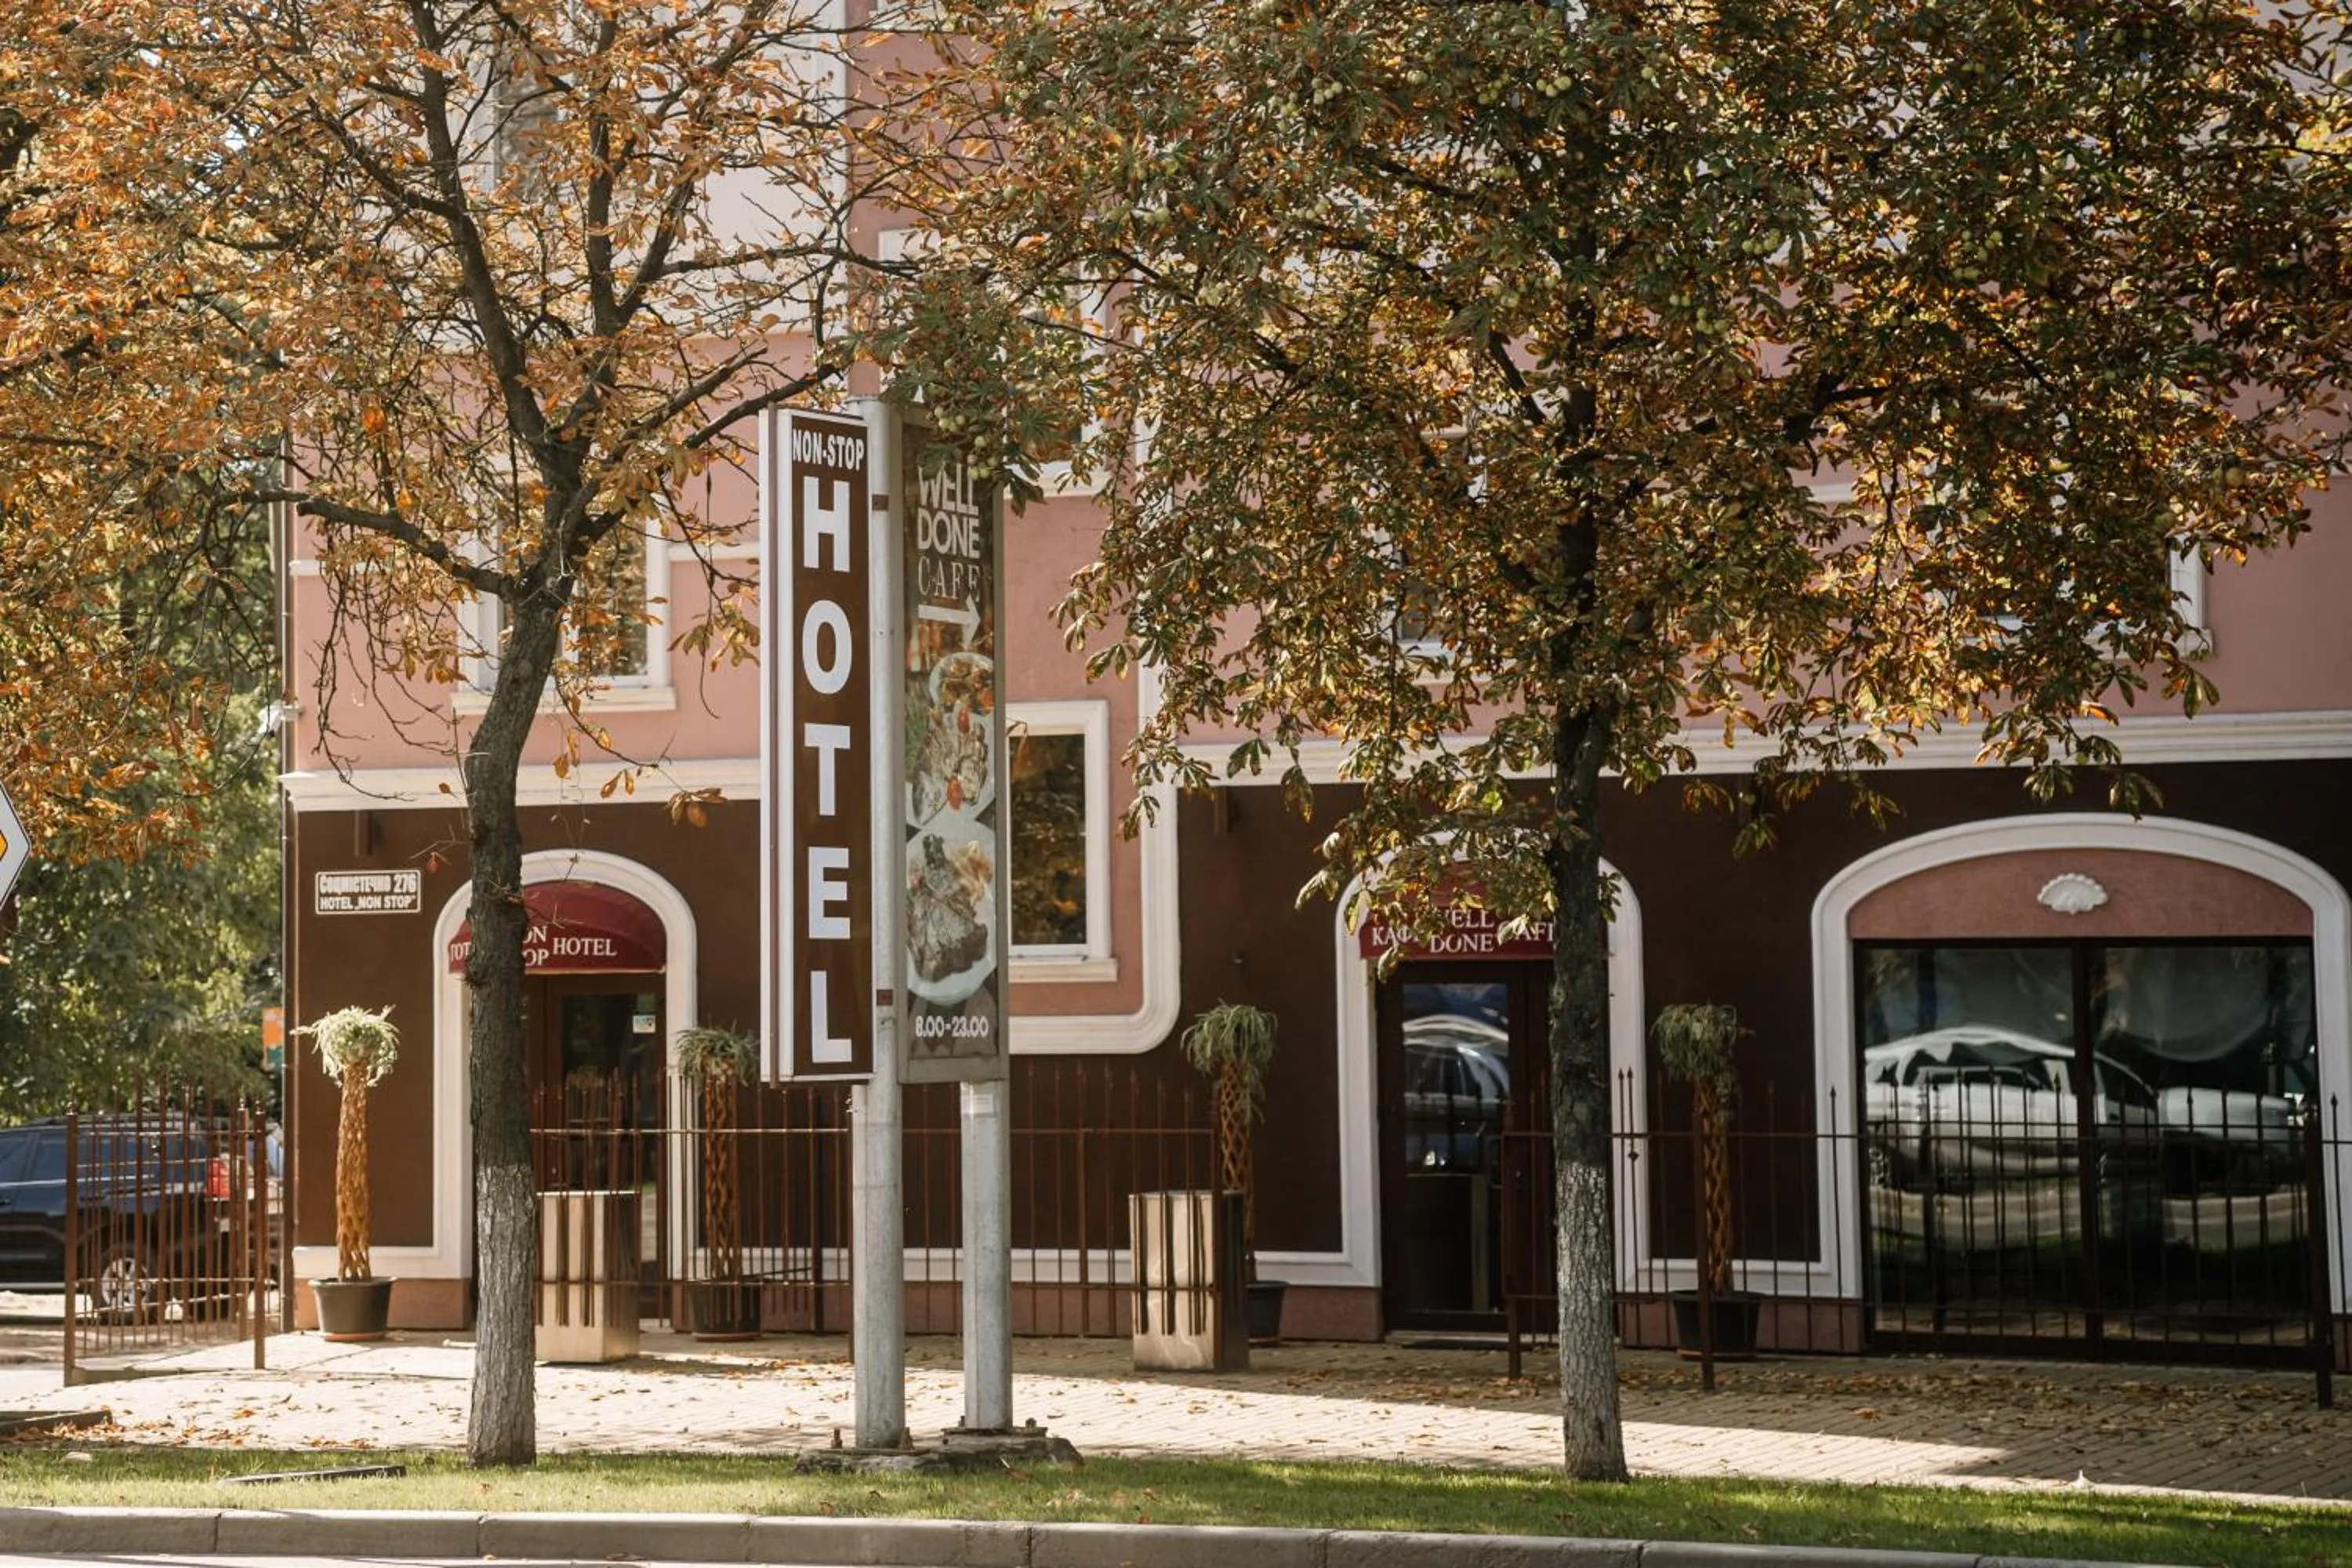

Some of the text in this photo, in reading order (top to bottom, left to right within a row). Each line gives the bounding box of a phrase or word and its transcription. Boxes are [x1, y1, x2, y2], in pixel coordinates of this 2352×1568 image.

[793, 430, 865, 470] NON-STOP
[917, 507, 979, 559] DONE
[801, 476, 852, 1063] HOTEL
[394, 873, 416, 893] 276
[320, 896, 353, 910] HOTEL
[1445, 909, 1494, 928] ELL
[1372, 924, 1419, 946] КАФ
[1430, 933, 1494, 953] DONE
[553, 937, 617, 956] HOTEL
